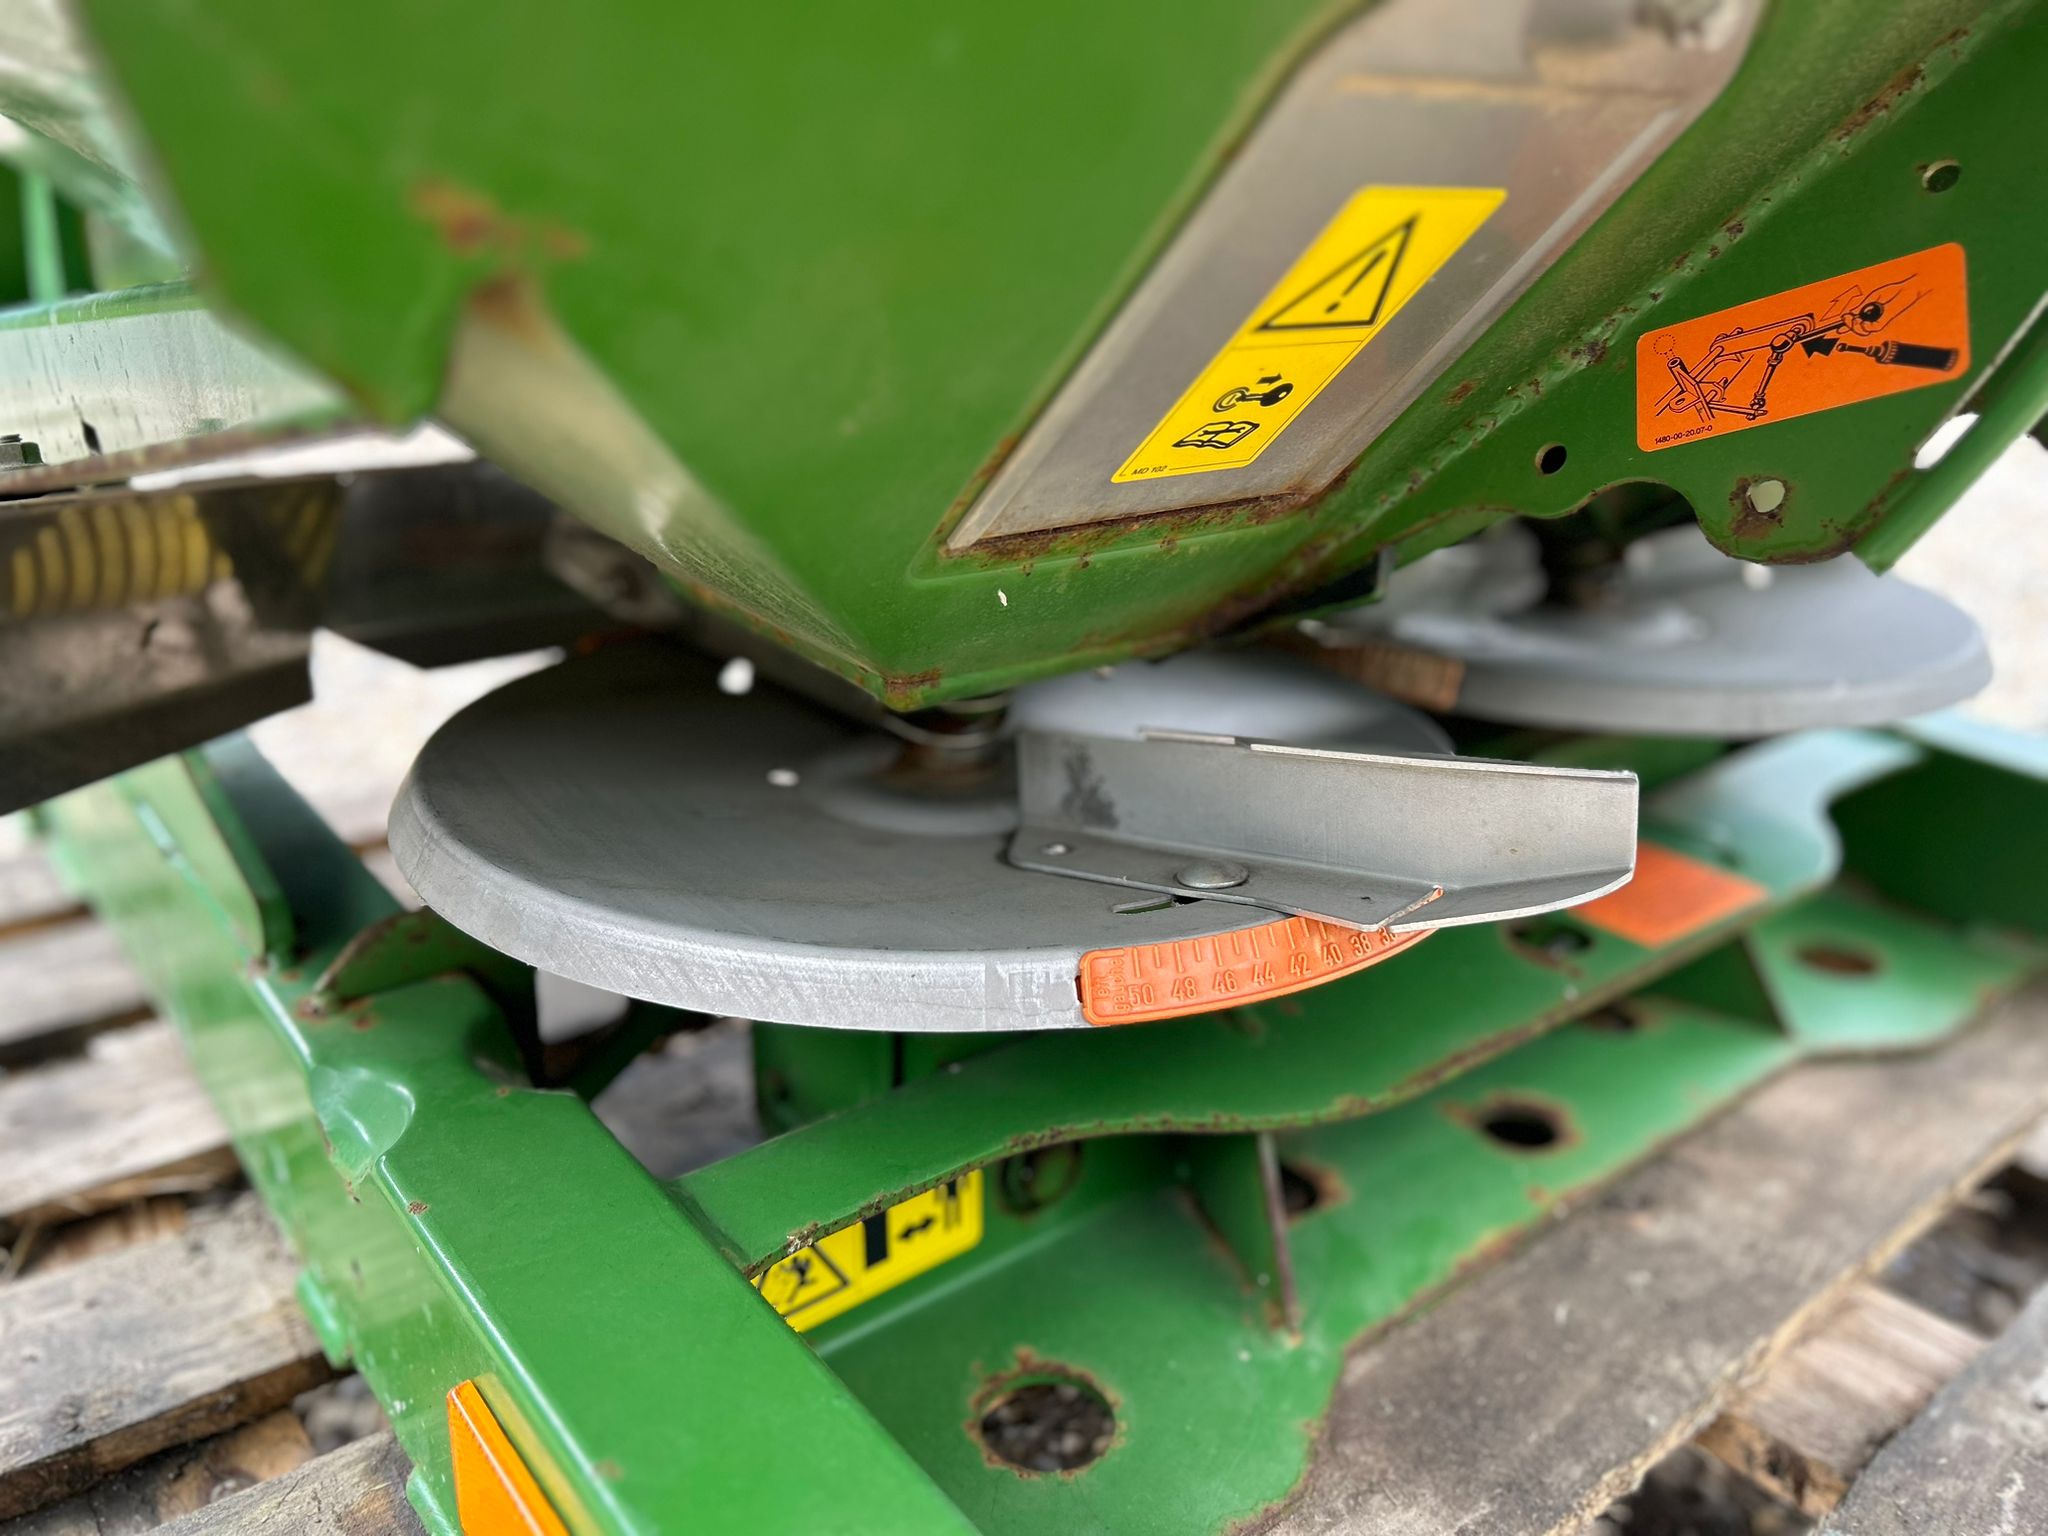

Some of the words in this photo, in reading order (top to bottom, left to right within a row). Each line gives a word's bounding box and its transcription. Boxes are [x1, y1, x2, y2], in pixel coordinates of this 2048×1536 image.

[1654, 424, 1713, 445] 1480-00-20.07-0
[1131, 467, 1149, 475] MD
[1127, 983, 1155, 1008] 50
[1171, 976, 1198, 1002] 48
[1212, 970, 1238, 994] 46
[1253, 962, 1276, 986] 44
[1290, 953, 1312, 977] 42
[1321, 943, 1344, 967] 40
[1350, 932, 1373, 957] 38
